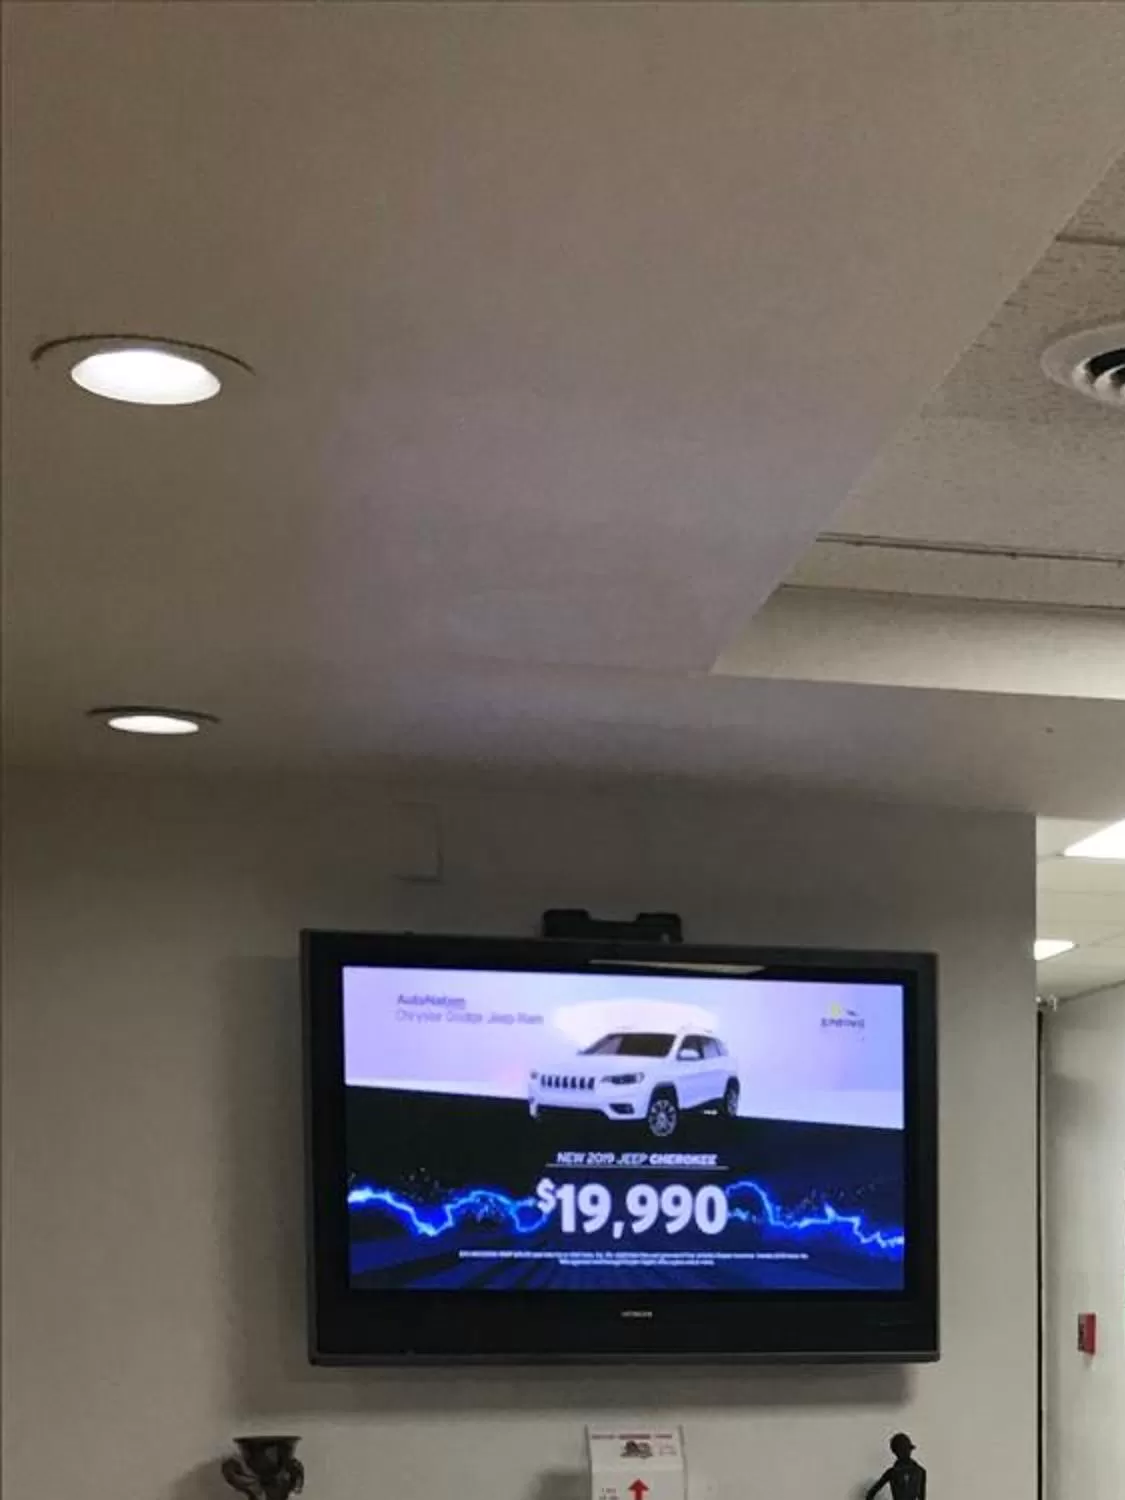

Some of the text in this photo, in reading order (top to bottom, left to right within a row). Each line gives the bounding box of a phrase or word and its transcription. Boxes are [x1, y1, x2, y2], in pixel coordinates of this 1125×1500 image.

[556, 1152, 717, 1166] NEW 2019 JEEP CHEROKEE
[536, 1176, 729, 1240] $19,990
